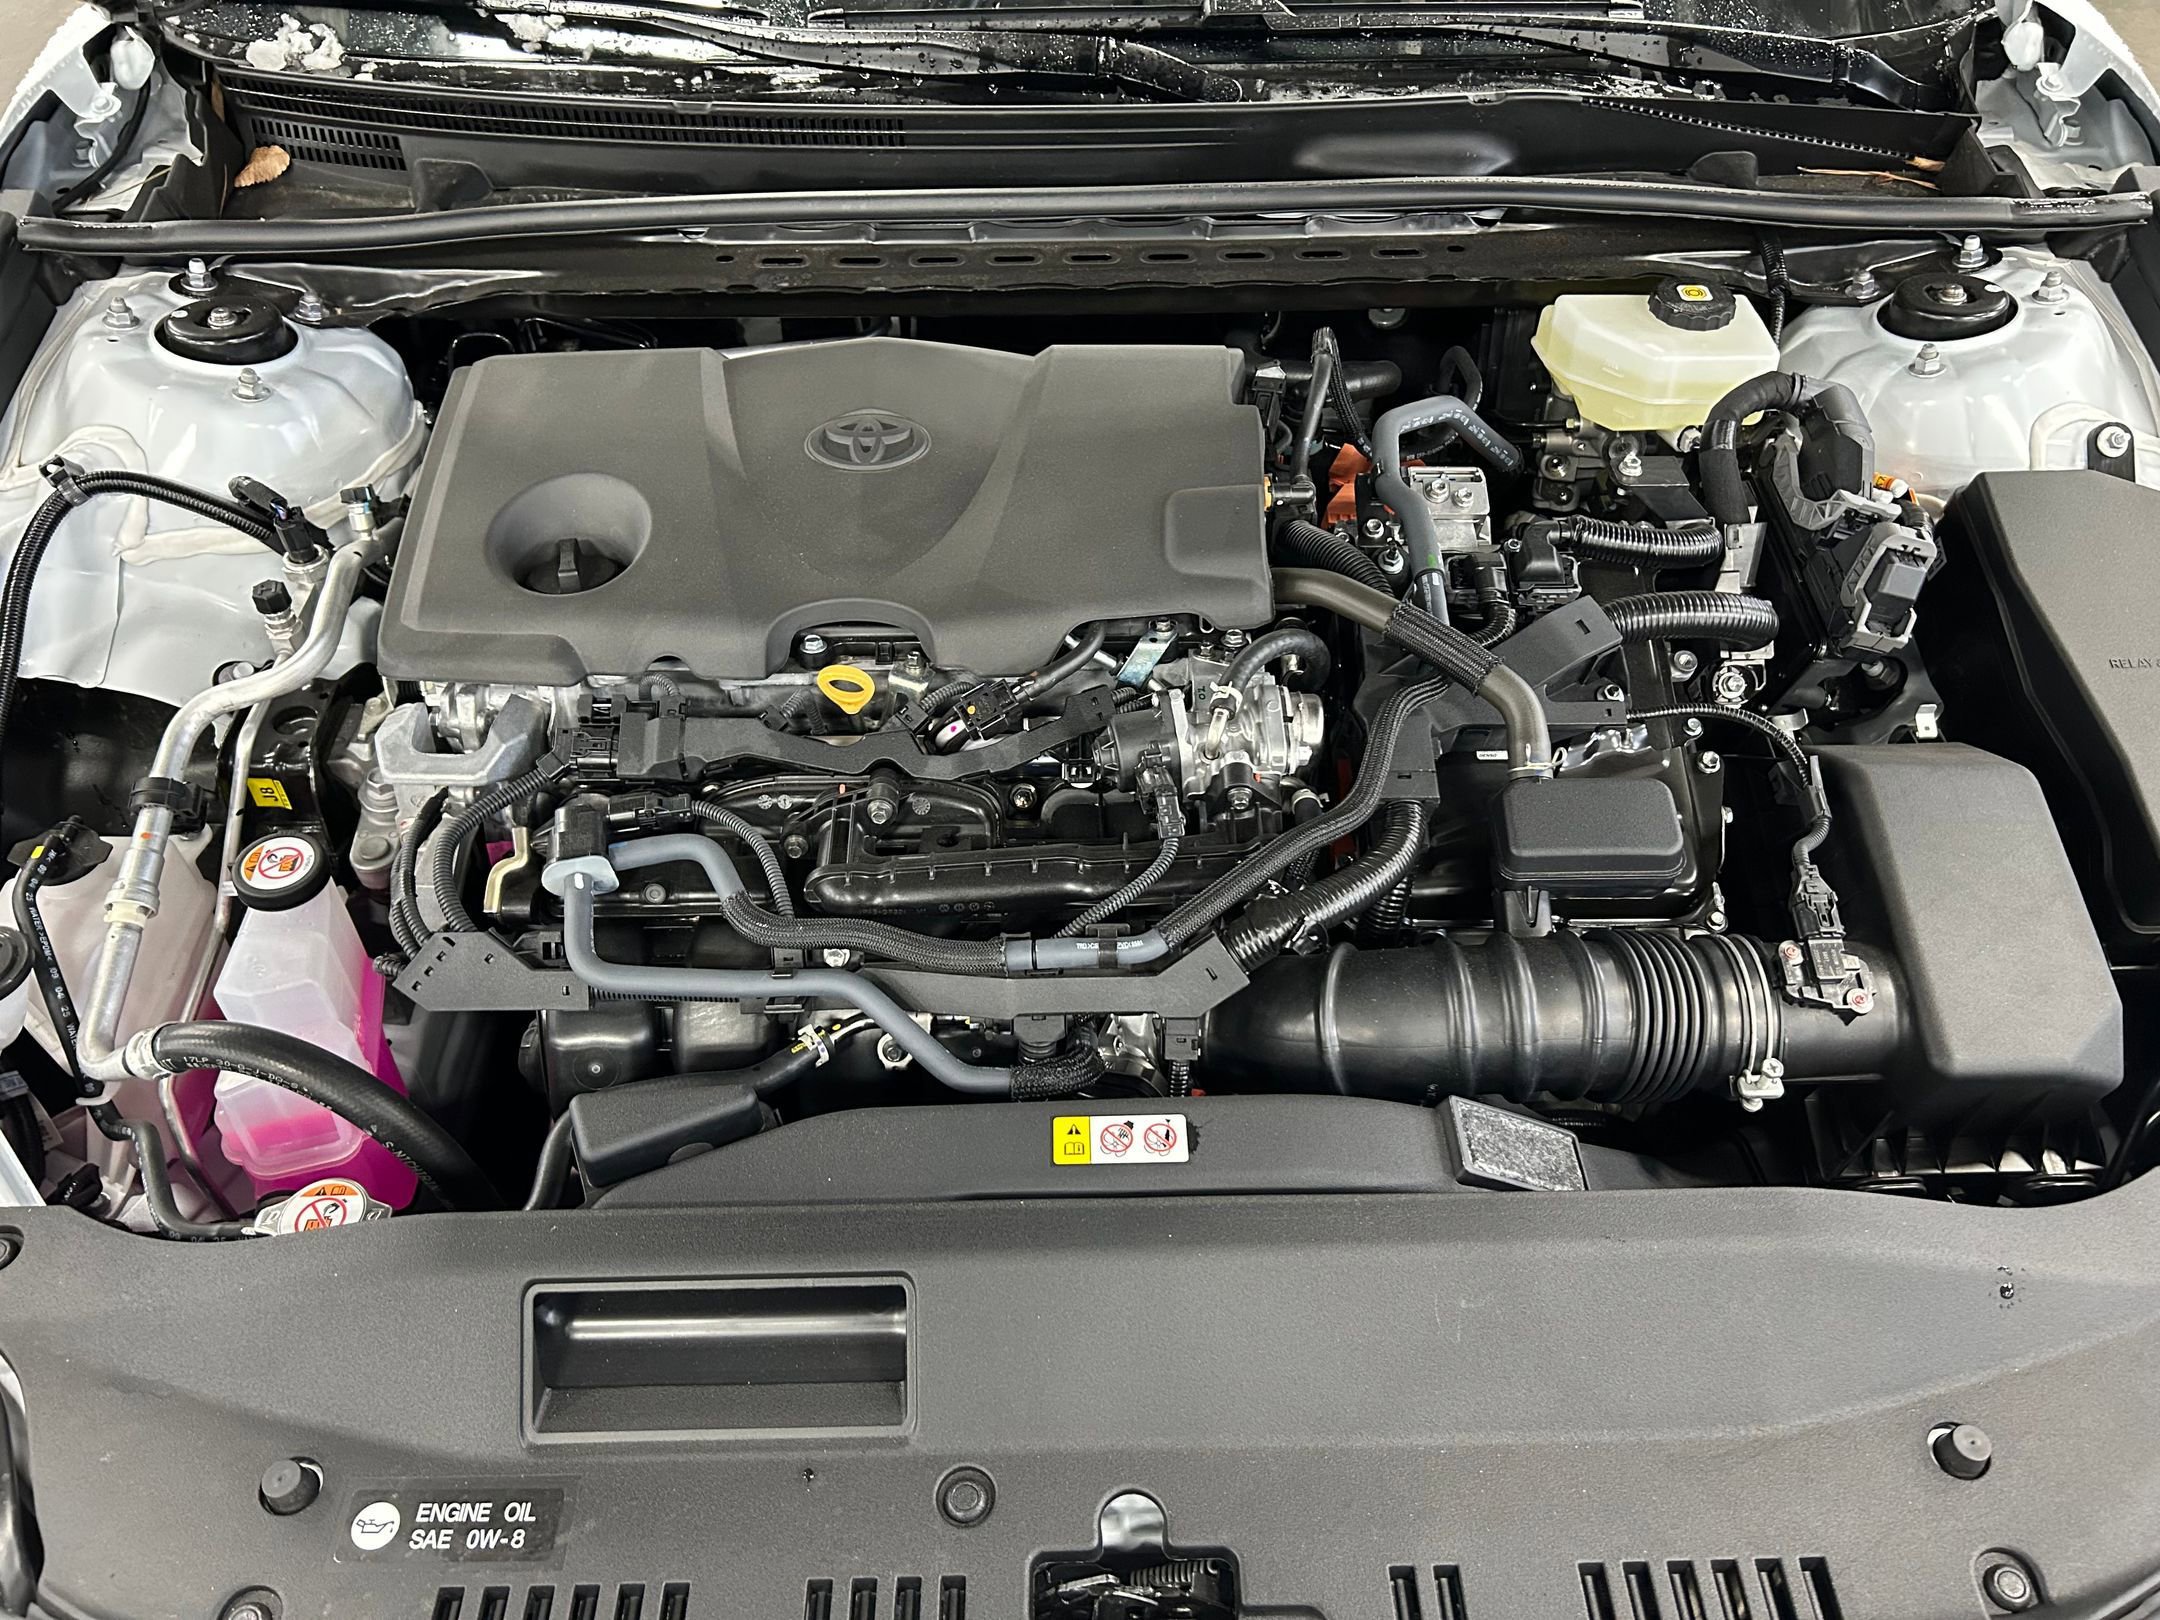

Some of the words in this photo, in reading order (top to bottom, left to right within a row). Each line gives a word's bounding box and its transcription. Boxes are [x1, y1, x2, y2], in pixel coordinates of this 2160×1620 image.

[2108, 658, 2152, 669] RELAY
[61, 1005, 70, 1018] 25
[415, 1502, 493, 1523] ENGINE
[503, 1501, 537, 1522] OIL
[408, 1529, 454, 1550] SAE
[466, 1528, 526, 1549] 0W-8
